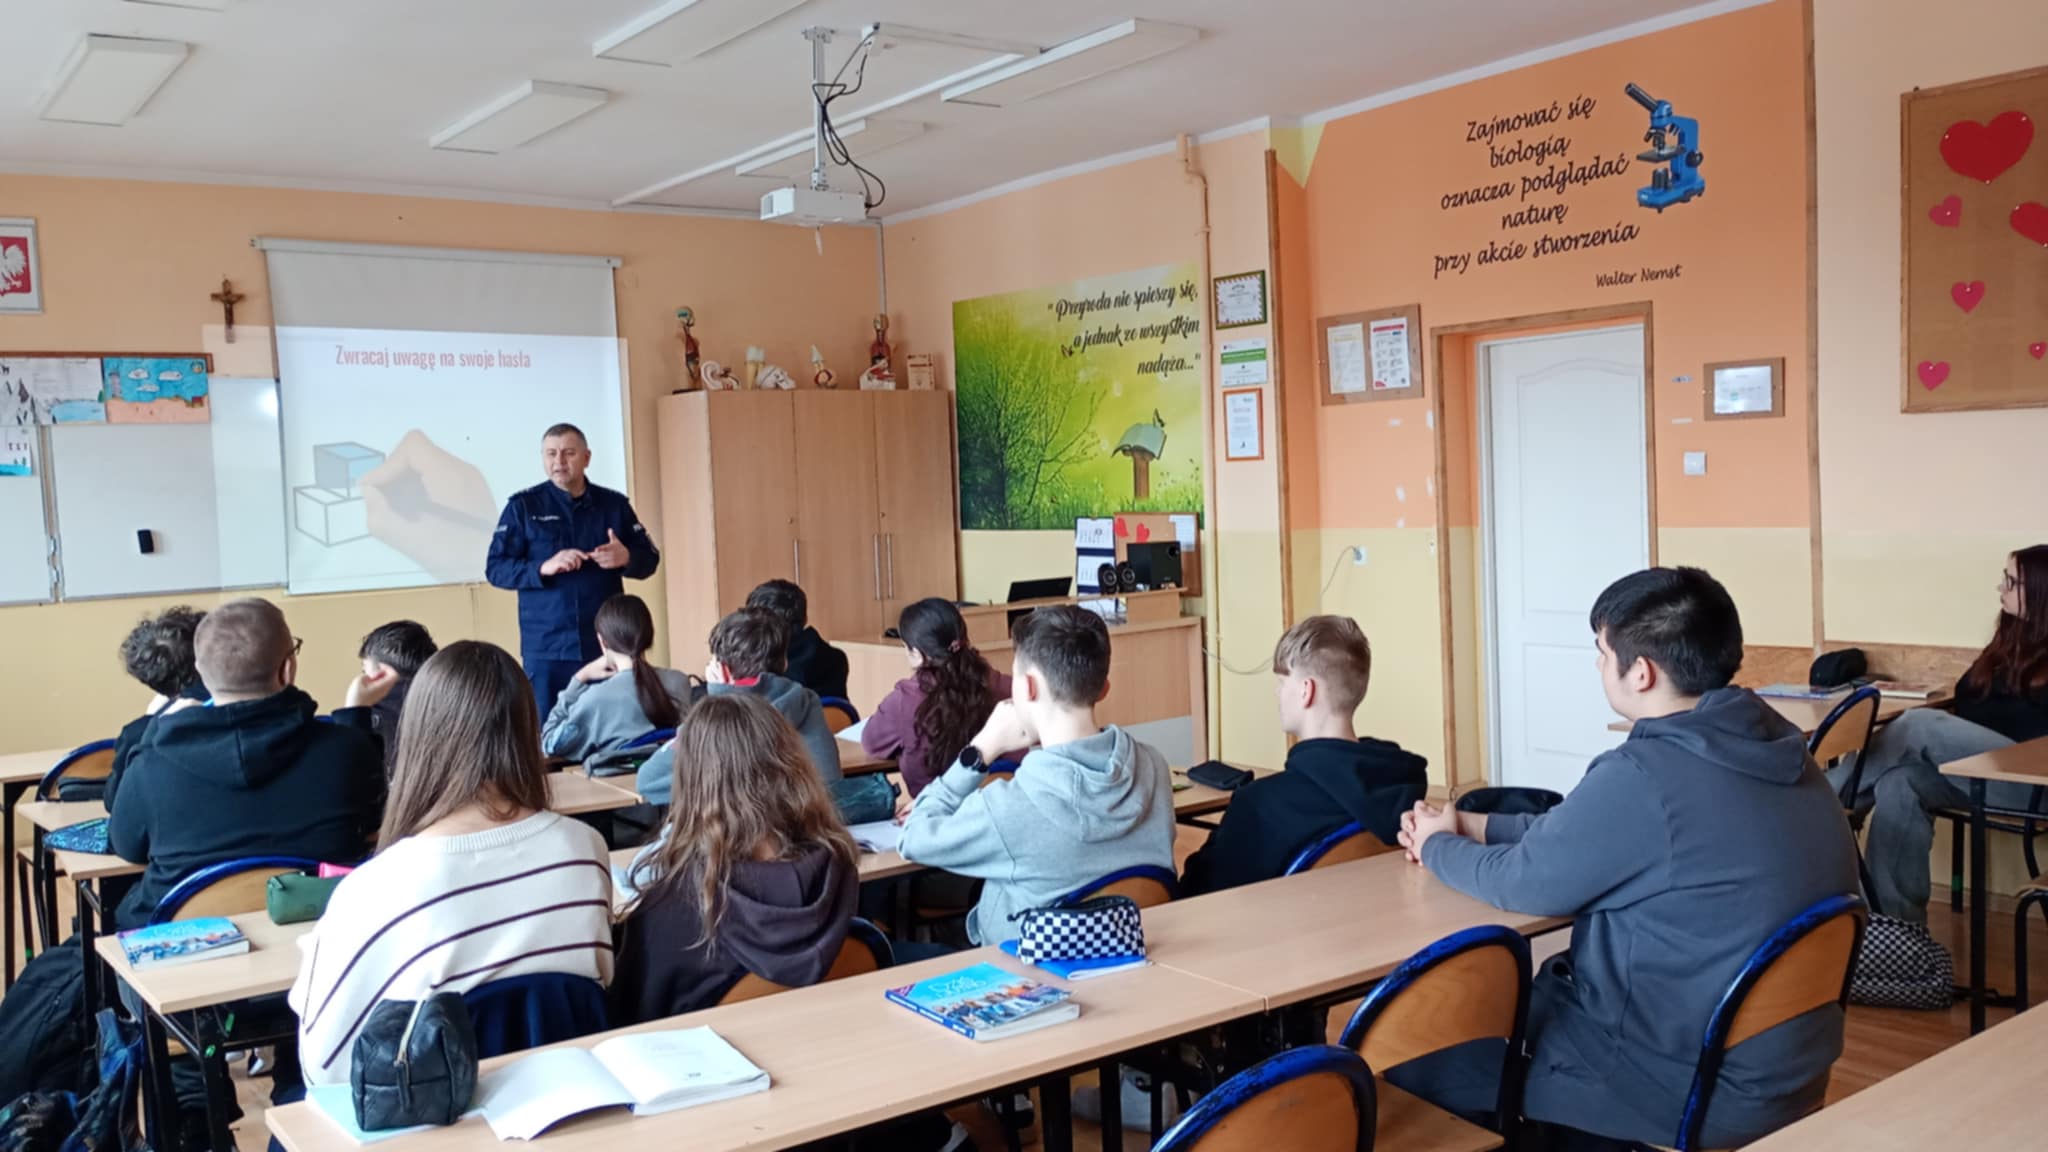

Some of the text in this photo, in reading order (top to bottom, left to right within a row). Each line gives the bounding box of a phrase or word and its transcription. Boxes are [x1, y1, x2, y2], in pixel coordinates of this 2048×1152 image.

[1466, 94, 1597, 145] Zajmować się
[1490, 134, 1571, 168] biologią
[1441, 152, 1630, 209] oznacza podglądać
[1502, 203, 1568, 230] naturę
[1434, 221, 1640, 280] przy akcie stworzenia
[1596, 270, 1637, 288] Walter
[1113, 290, 1133, 308] nie
[1134, 286, 1176, 312] spieszy
[1073, 315, 1200, 354] a jednak ze wszystkim
[336, 345, 389, 368] Zwracaj
[393, 351, 436, 370] uwagę
[440, 352, 456, 366] na
[459, 352, 495, 370] swoje
